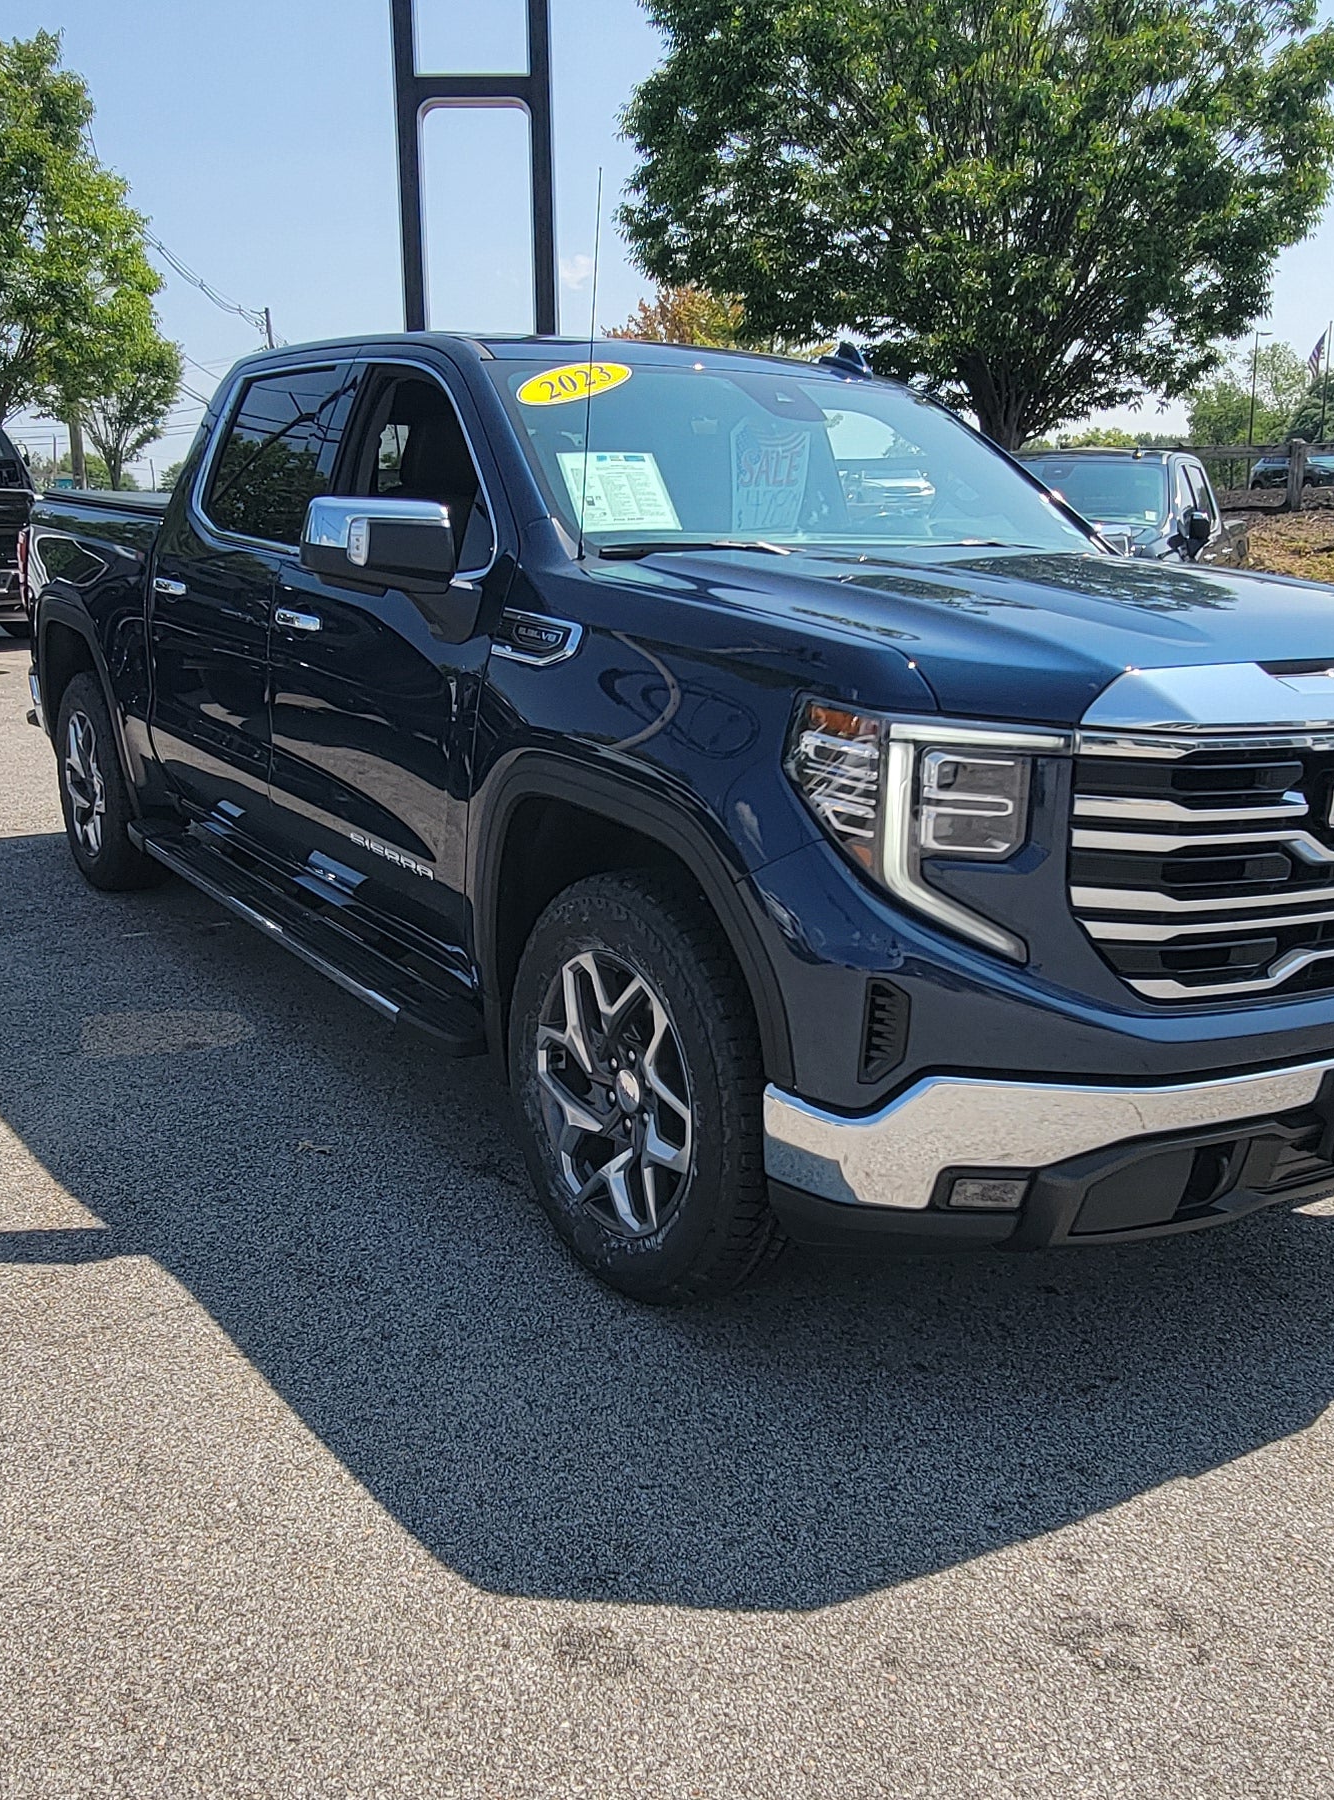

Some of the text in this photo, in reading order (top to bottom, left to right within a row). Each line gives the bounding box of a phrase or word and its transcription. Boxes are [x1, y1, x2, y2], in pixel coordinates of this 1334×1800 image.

[539, 366, 611, 400] 2023
[740, 448, 801, 488] SALE
[350, 832, 434, 881] SIERRA
